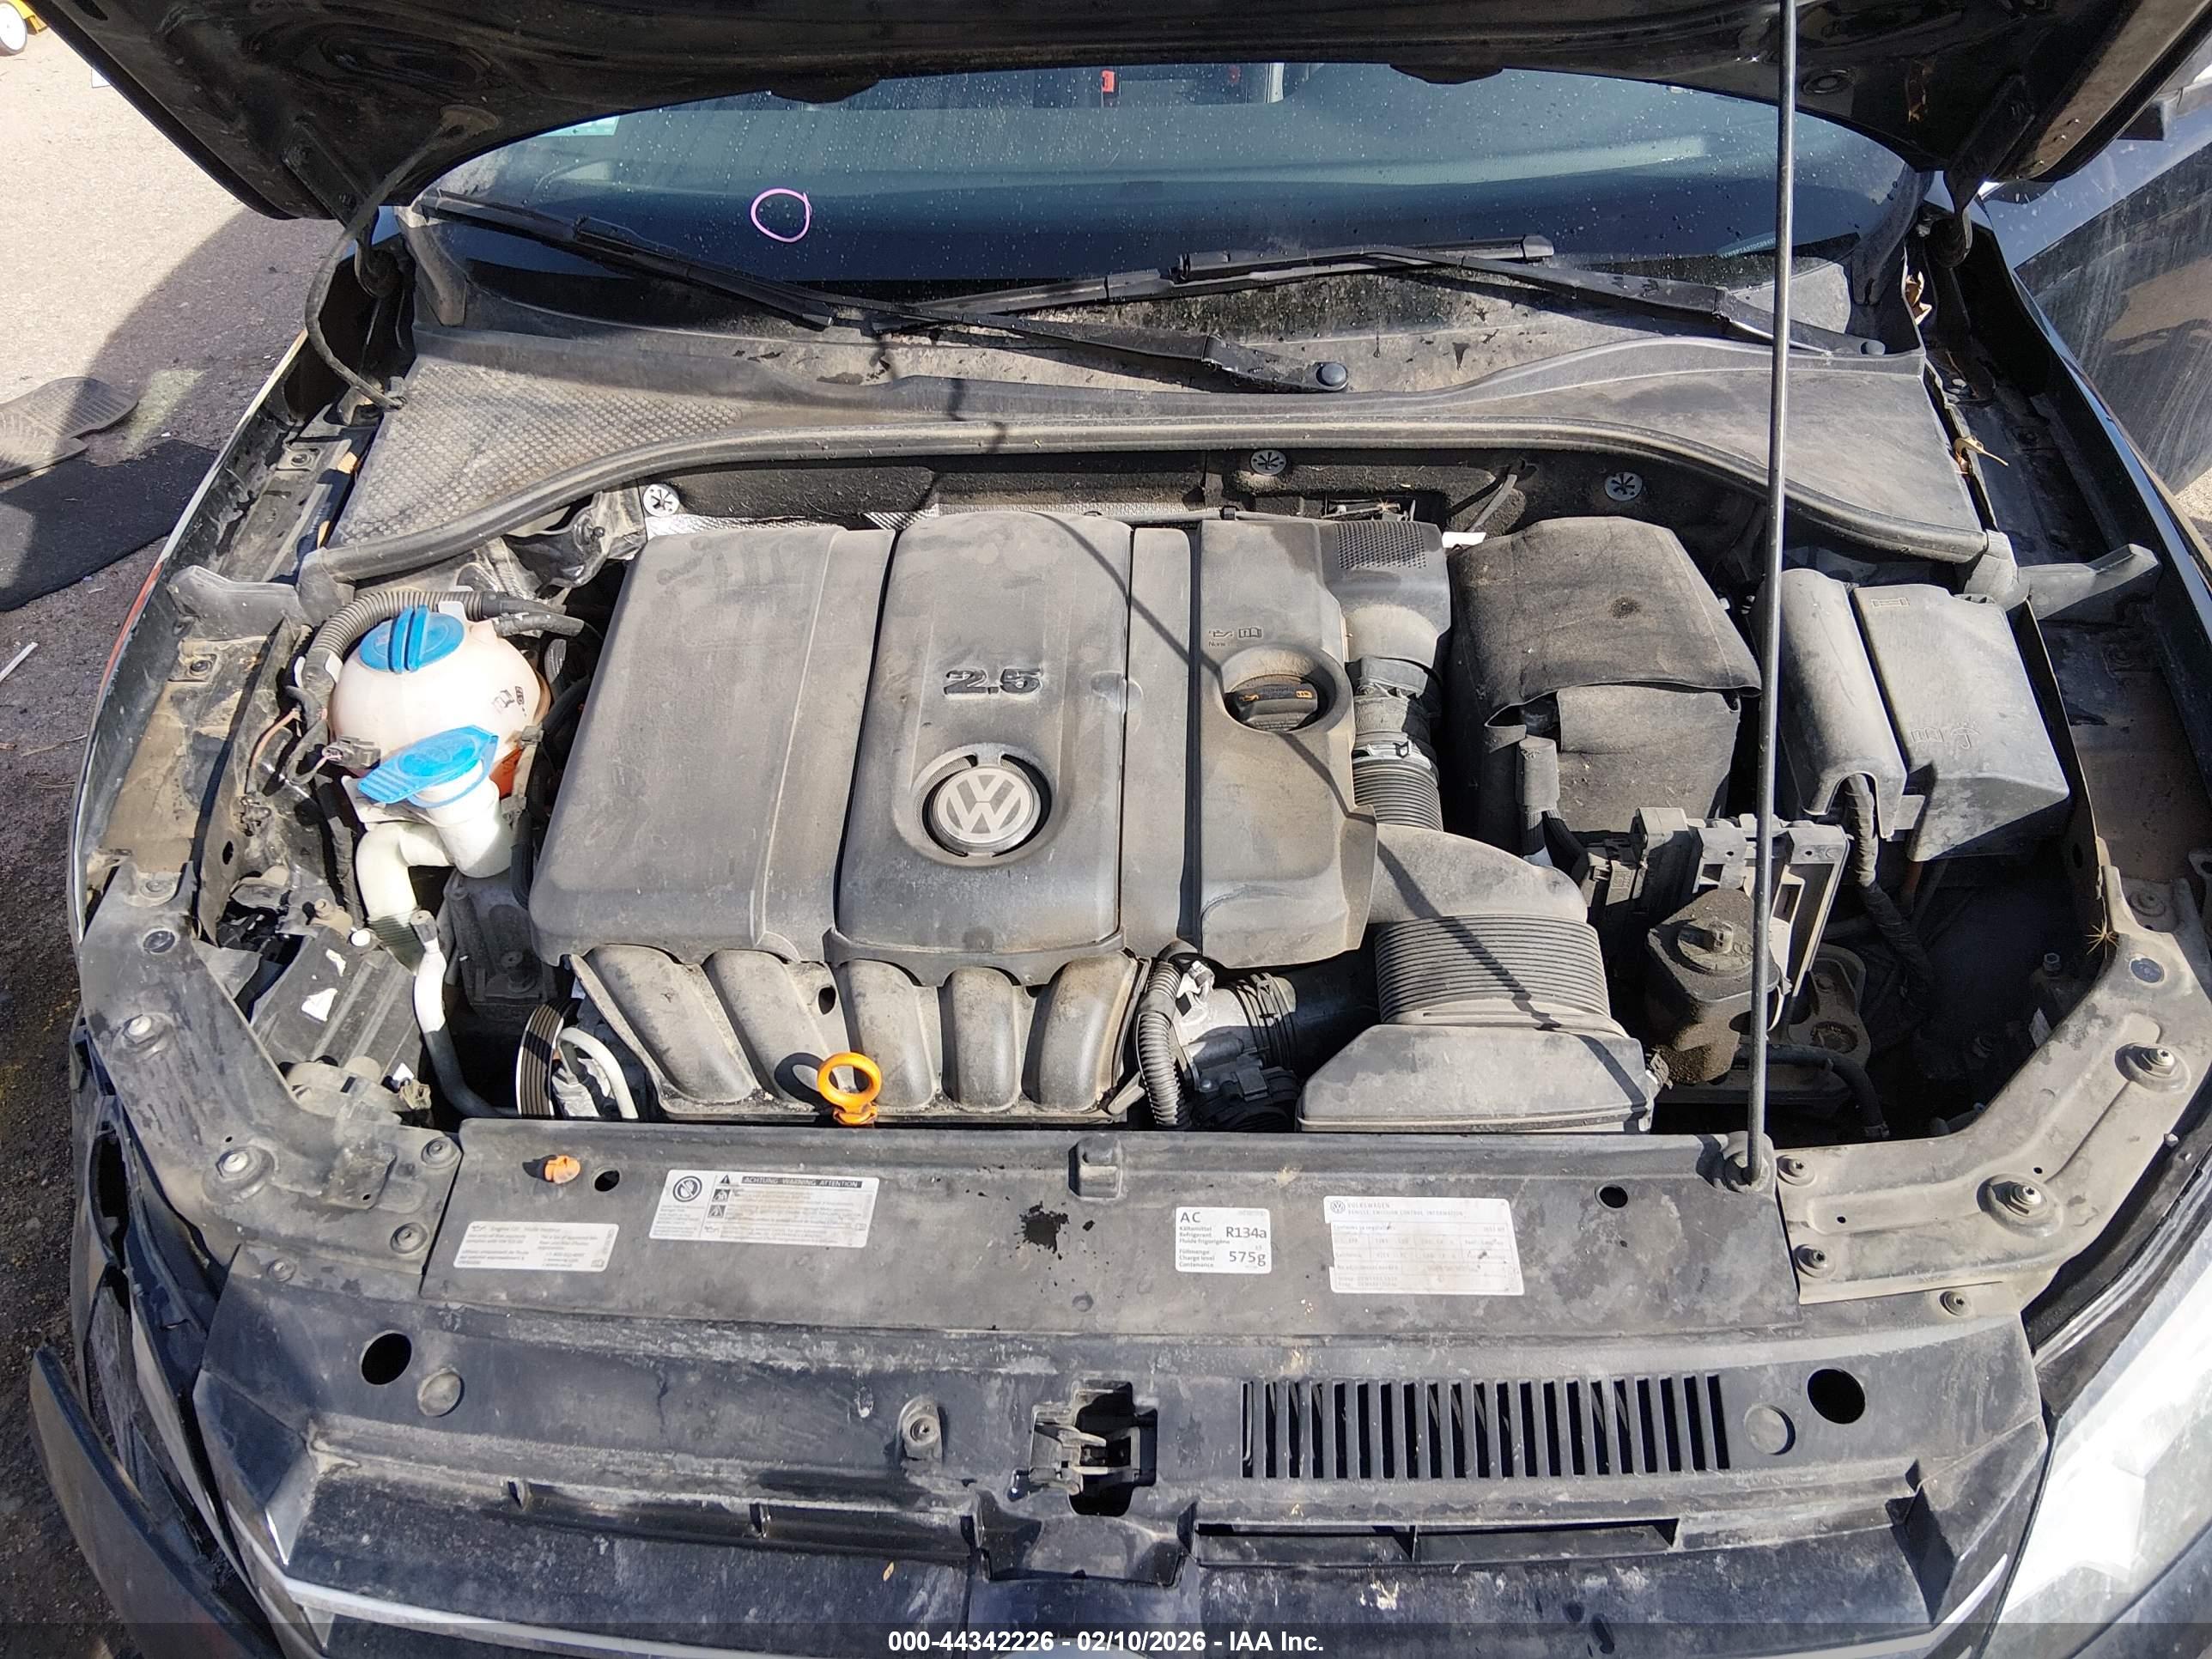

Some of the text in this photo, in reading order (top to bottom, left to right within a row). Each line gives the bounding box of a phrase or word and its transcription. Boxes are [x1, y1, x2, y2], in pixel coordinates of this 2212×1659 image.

[944, 667, 1043, 697] 2.5
[1180, 1212, 1201, 1224] AC
[1225, 1226, 1267, 1239] R134a
[1229, 1251, 1267, 1267] 575g
